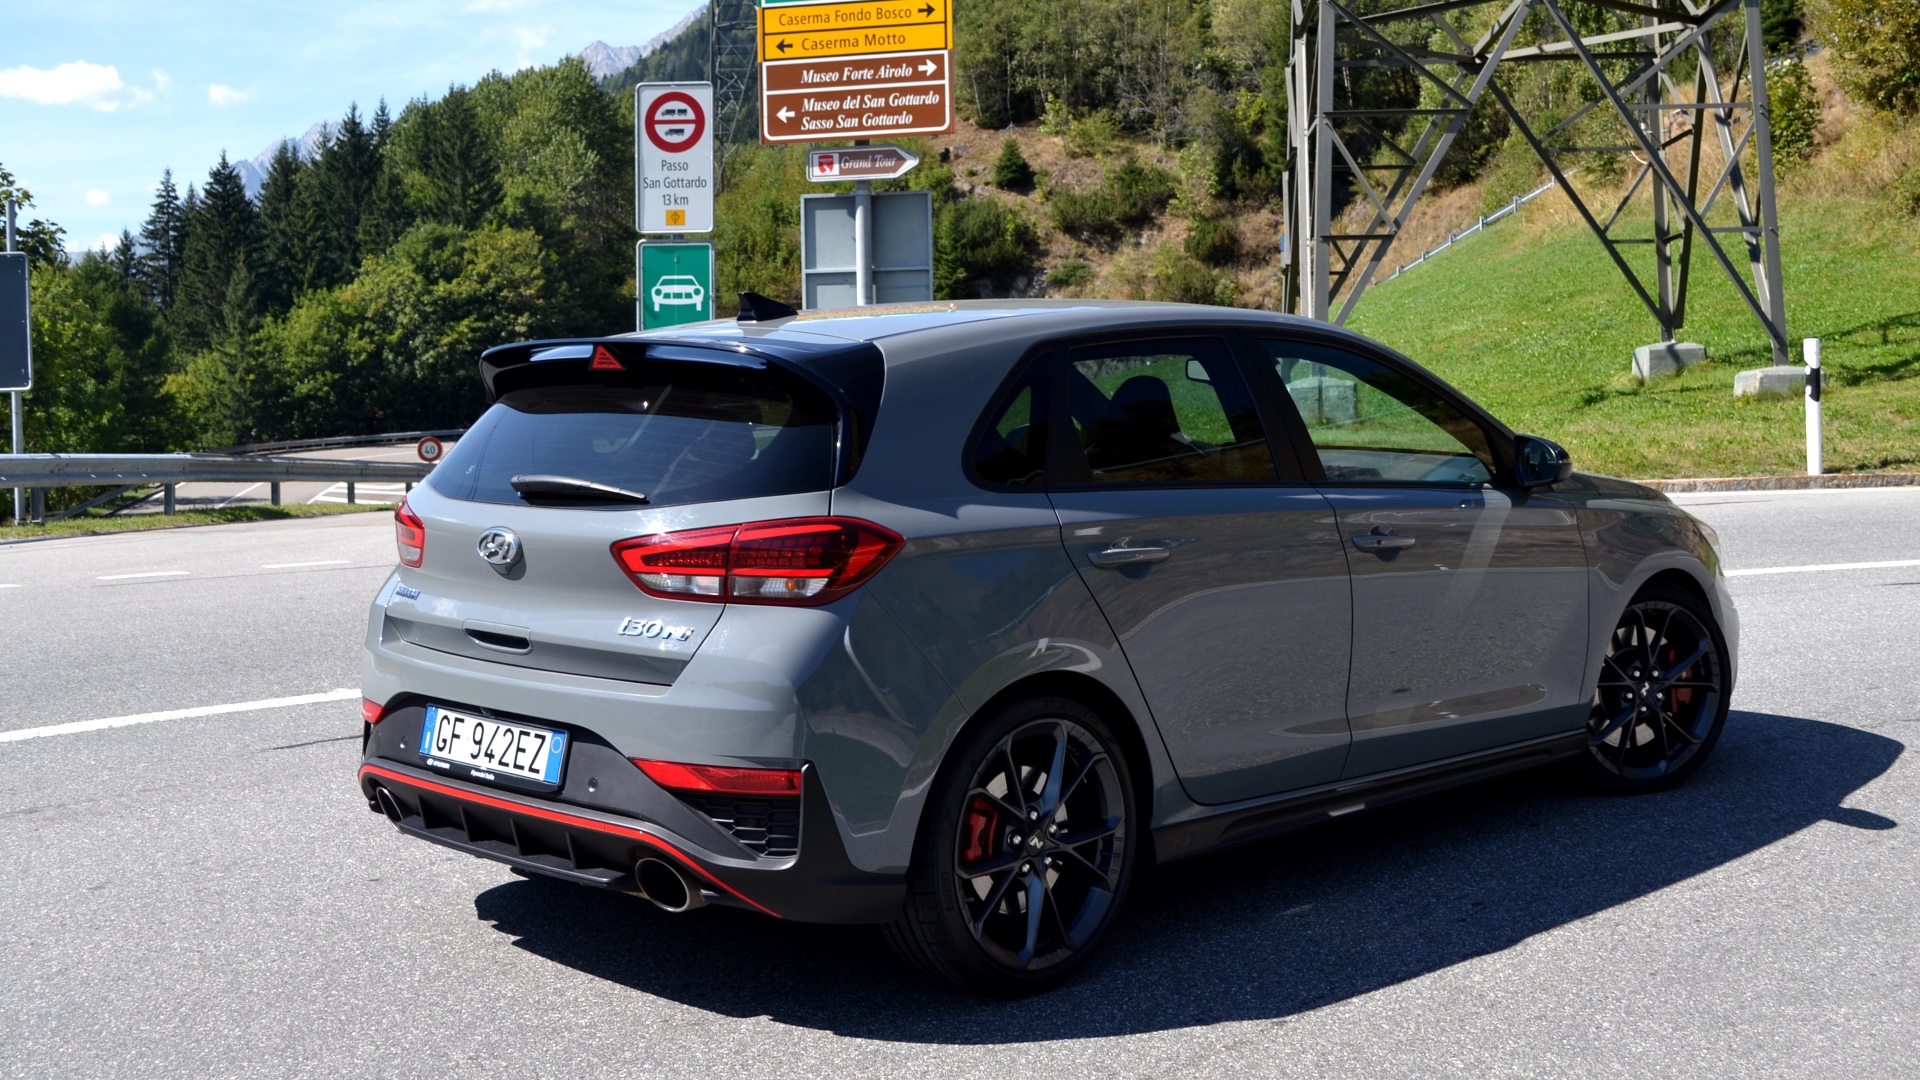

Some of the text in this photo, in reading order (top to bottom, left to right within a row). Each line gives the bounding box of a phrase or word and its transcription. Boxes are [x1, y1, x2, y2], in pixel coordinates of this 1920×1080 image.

[779, 8, 912, 26] Caserma Fondo Bosco
[802, 33, 906, 51] Caserma Motto
[800, 63, 913, 84] Museo Forte Airolo
[802, 91, 939, 112] Museo del San Gottardo
[801, 111, 913, 131] Sasso San Gottardo
[661, 160, 689, 172] Passo
[841, 154, 897, 170] Grand Tour
[643, 176, 707, 189] San Gottardo
[662, 193, 689, 206] 13 km
[425, 445, 436, 455] 40
[617, 616, 664, 639] i30
[436, 714, 547, 775] GF 942EZ
